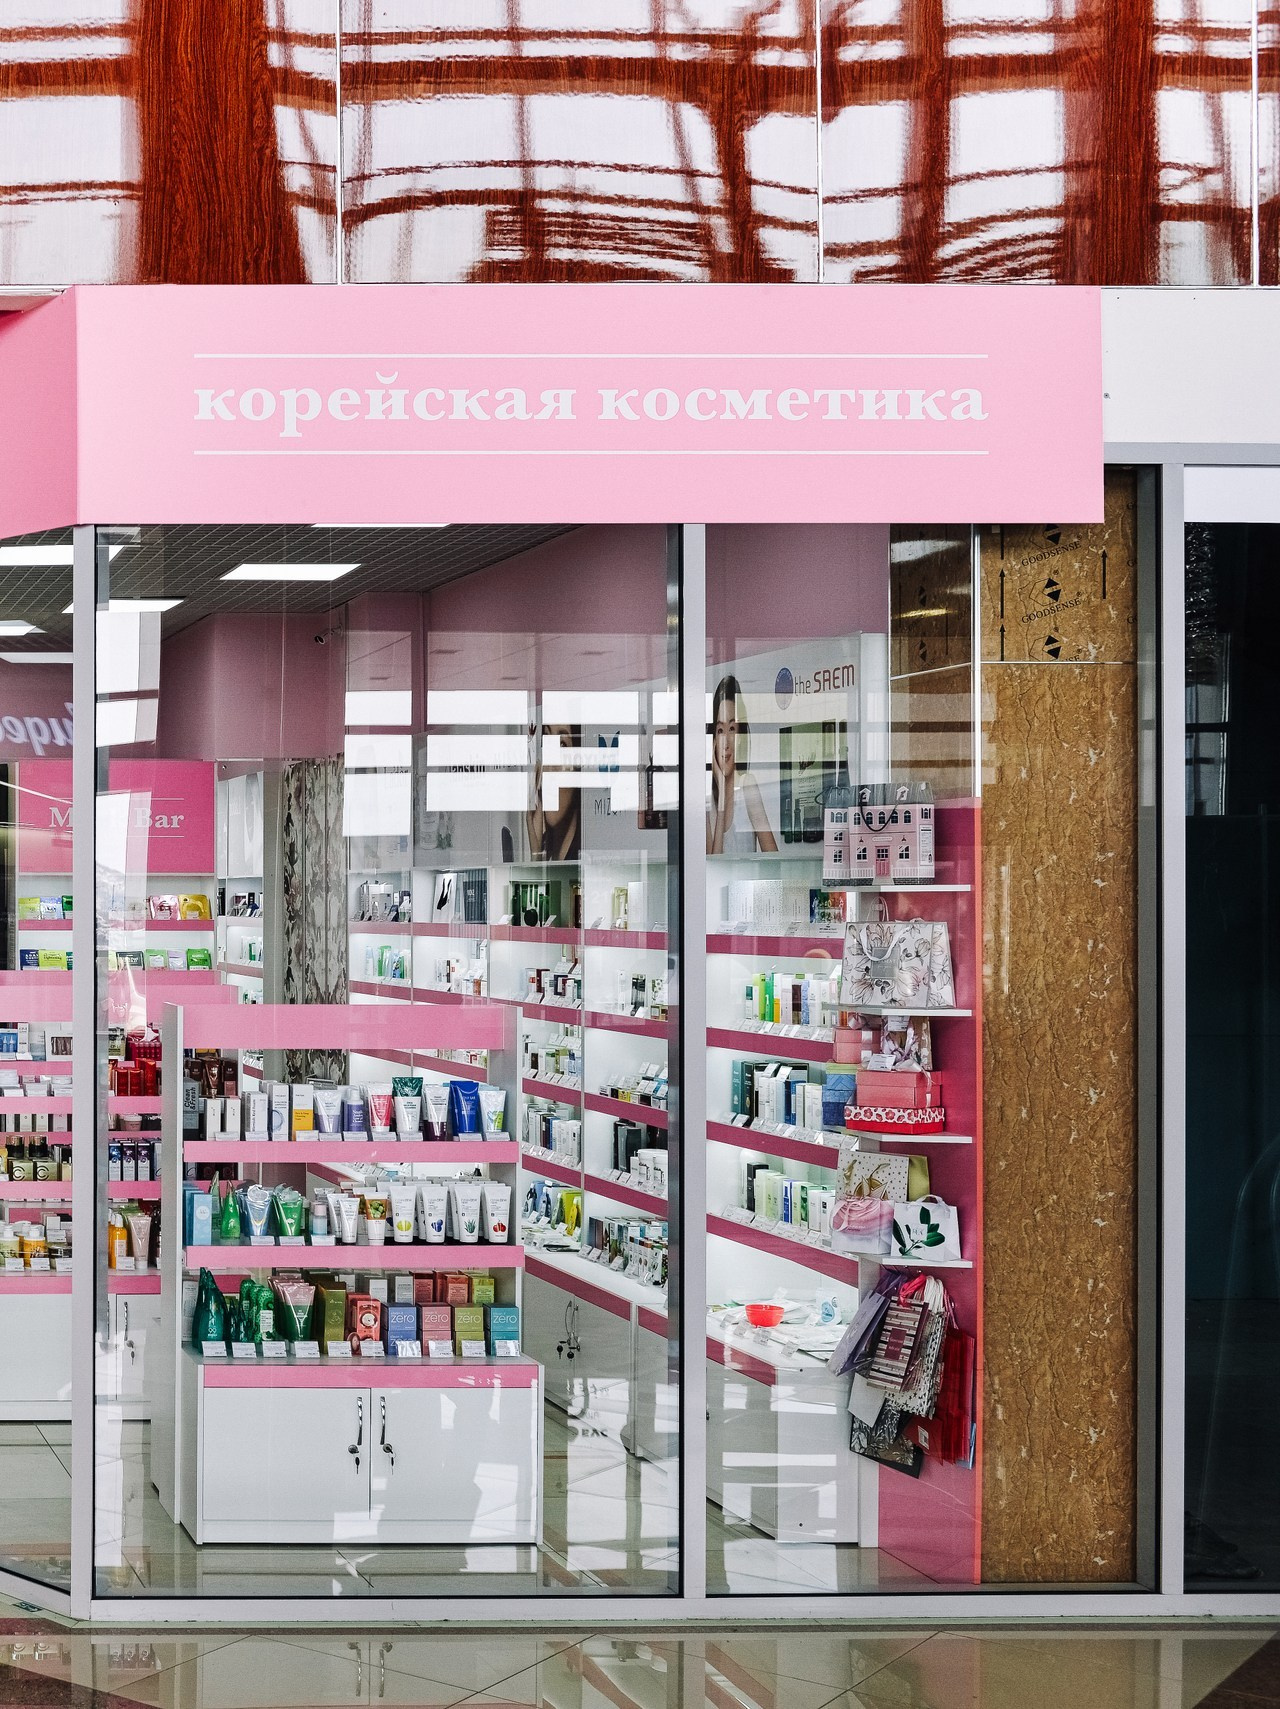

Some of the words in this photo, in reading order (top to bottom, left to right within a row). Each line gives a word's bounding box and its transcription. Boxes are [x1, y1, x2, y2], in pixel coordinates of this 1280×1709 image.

[194, 371, 578, 437] корейская
[599, 386, 989, 422] косметика
[1021, 540, 1082, 567] GOODSENSE
[1021, 598, 1082, 624] GOODSENSE
[794, 675, 812, 696] the
[813, 664, 855, 693] SAEM
[134, 806, 185, 828] Bar
[390, 1314, 415, 1324] zero
[424, 1313, 449, 1323] zero
[492, 1314, 518, 1324] zero
